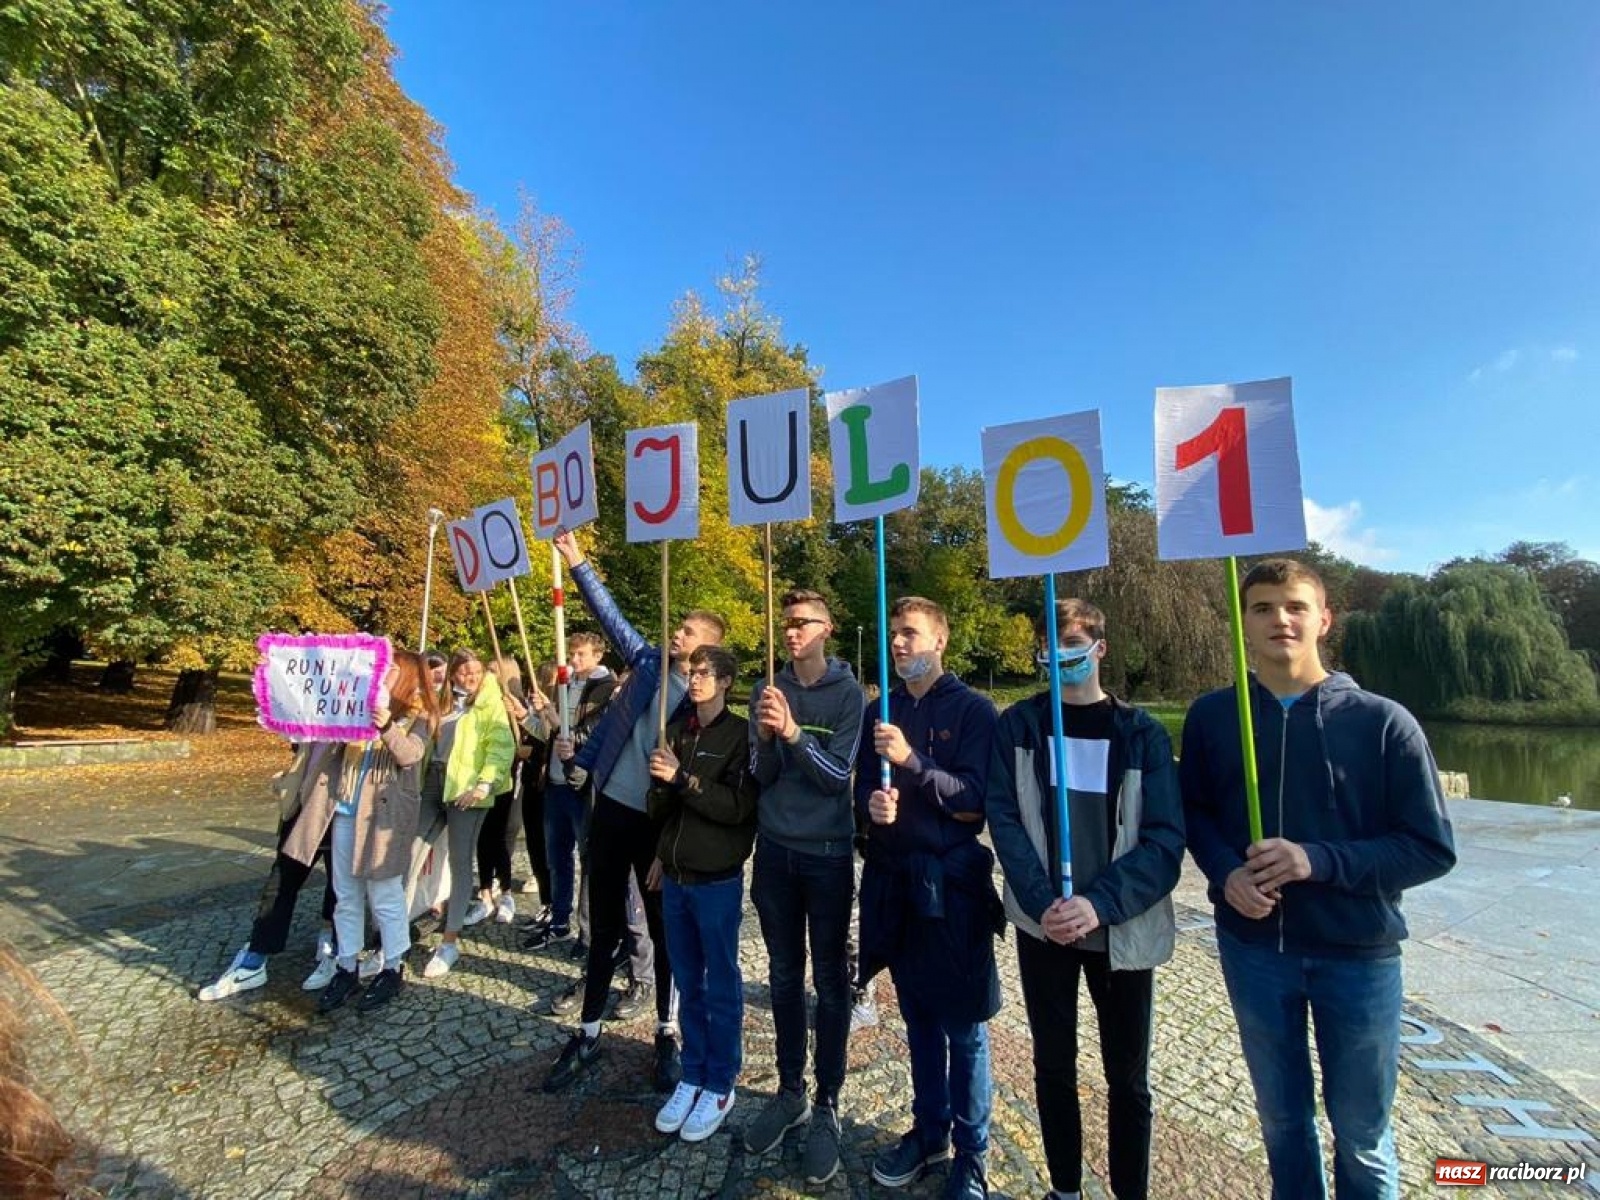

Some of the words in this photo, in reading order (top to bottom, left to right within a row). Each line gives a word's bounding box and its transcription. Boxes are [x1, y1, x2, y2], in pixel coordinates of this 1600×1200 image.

[1174, 407, 1256, 537] 1
[285, 658, 337, 676] RUN!
[303, 676, 361, 698] RUN!
[315, 698, 365, 718] RUN!
